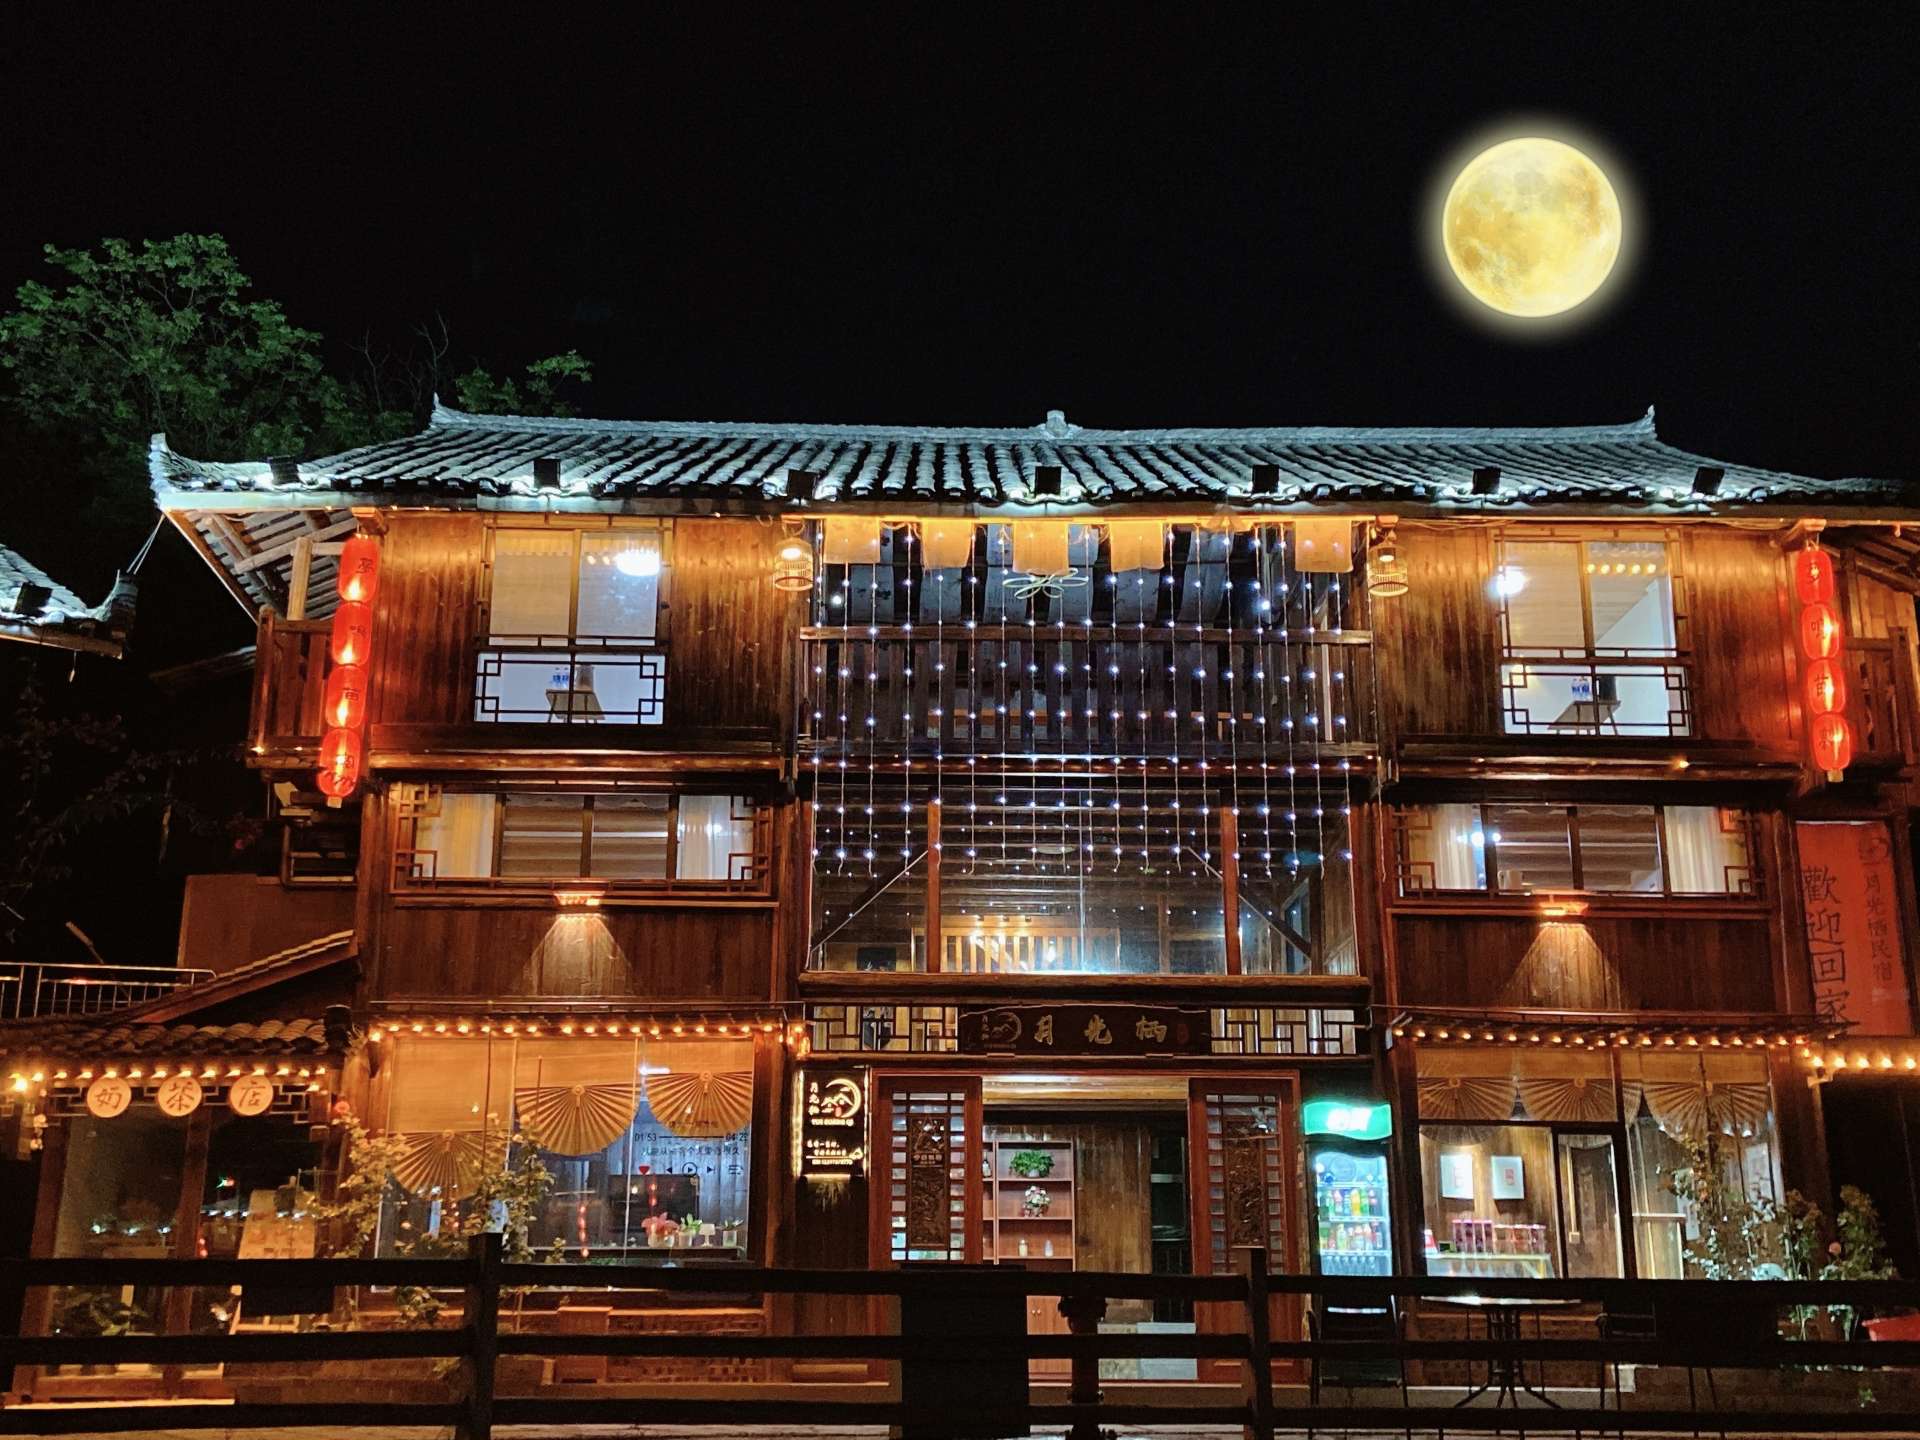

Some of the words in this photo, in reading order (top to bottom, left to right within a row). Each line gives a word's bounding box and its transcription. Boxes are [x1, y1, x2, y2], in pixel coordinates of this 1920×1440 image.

[1034, 1013, 1167, 1046] 月光栖
[94, 1080, 266, 1111] 奶茶店
